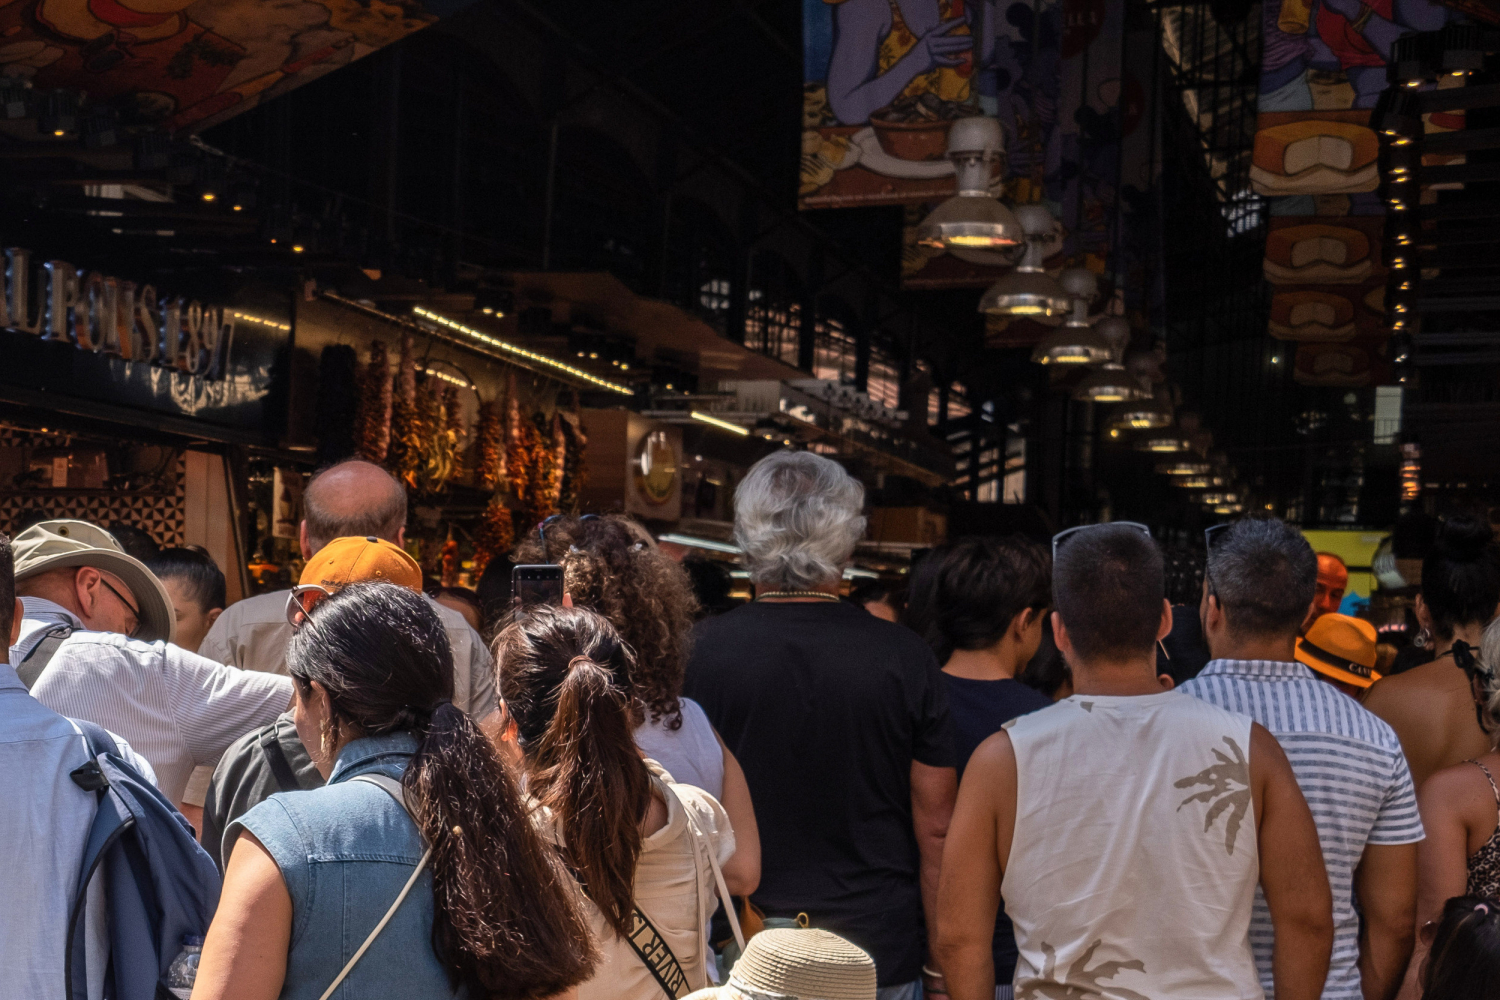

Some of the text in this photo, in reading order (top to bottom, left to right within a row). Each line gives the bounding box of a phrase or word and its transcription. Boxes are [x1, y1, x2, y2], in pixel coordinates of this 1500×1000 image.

[44, 259, 161, 362] PONS
[160, 296, 236, 381] 1897
[642, 933, 685, 997] RIVER
